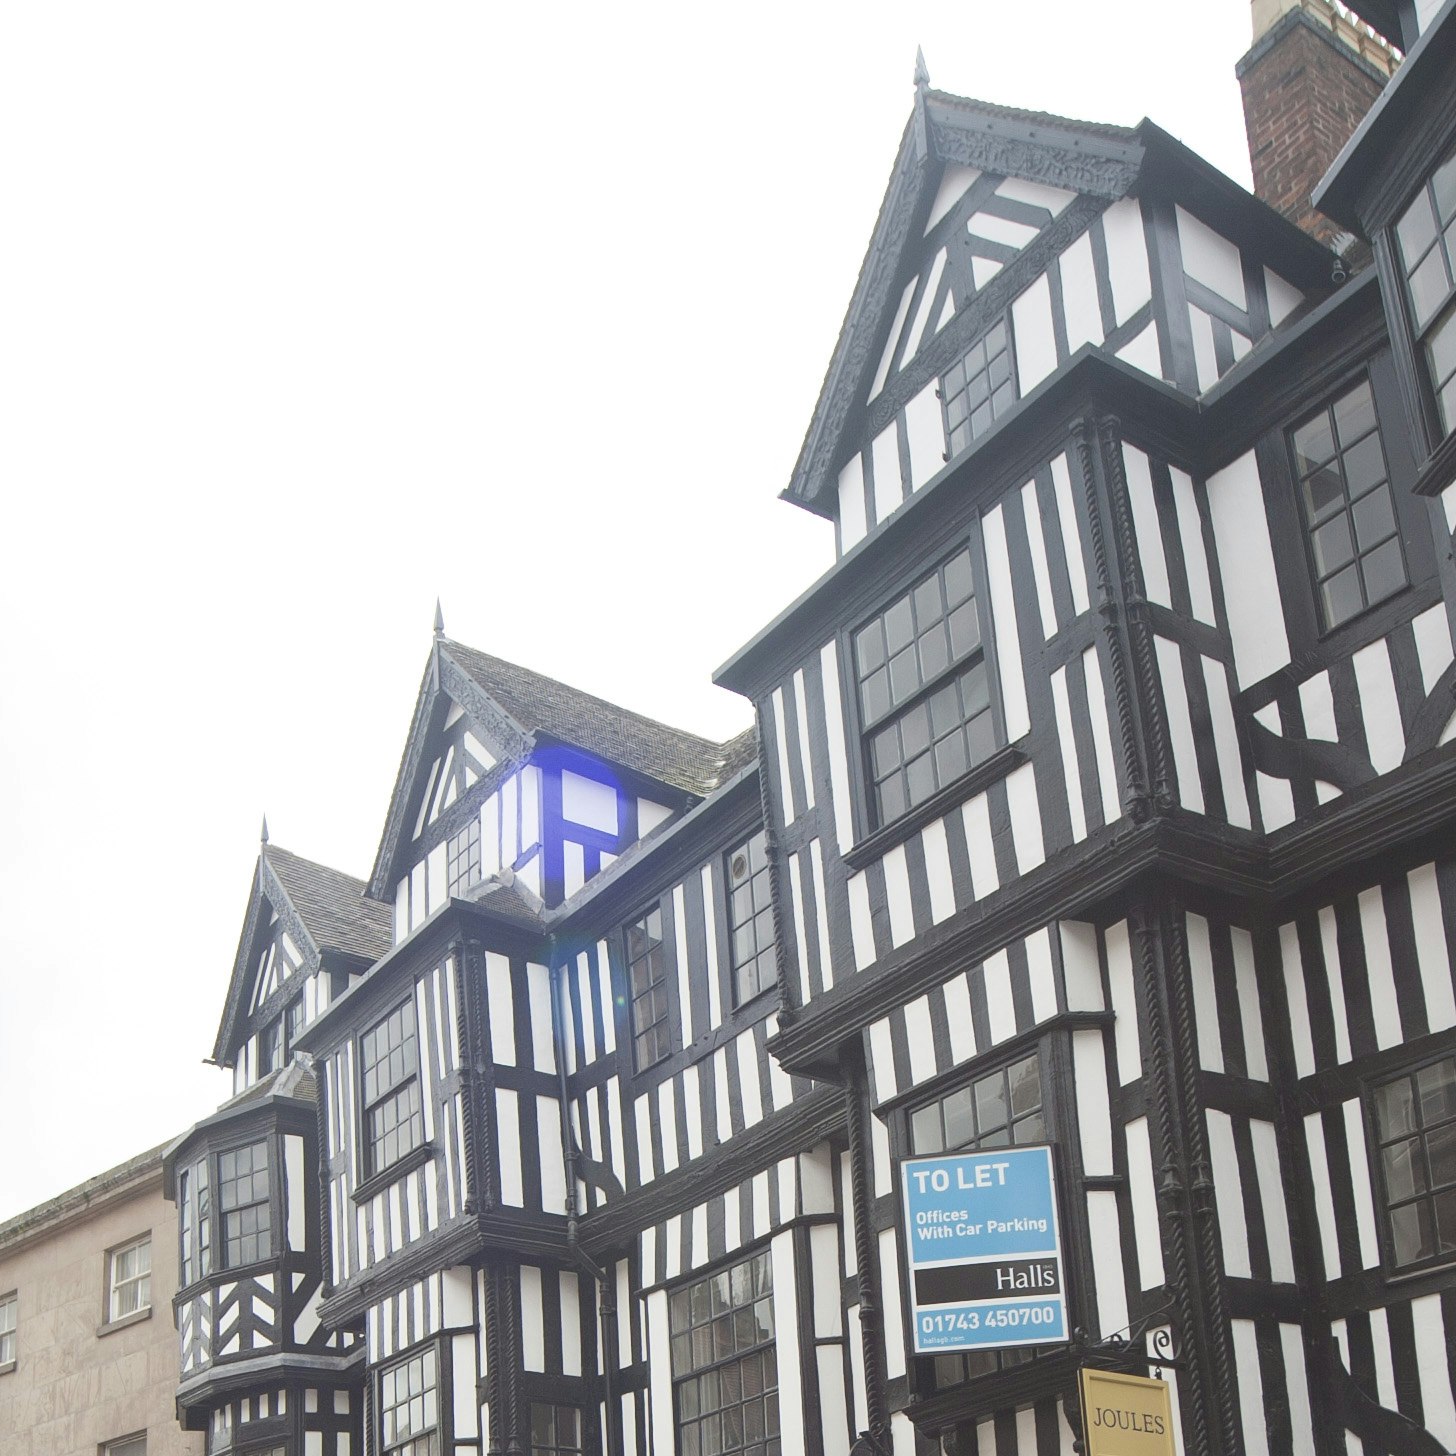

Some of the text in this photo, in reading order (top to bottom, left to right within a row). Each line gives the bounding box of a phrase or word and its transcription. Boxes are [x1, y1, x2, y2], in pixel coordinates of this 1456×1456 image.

[913, 1162, 1010, 1194] TO LET
[916, 1209, 968, 1225] Offices
[917, 1217, 1048, 1241] With Car Parking
[995, 1264, 1055, 1290] Halls
[922, 1306, 1055, 1334] 01743 450700
[1092, 1407, 1166, 1436] JOULES
